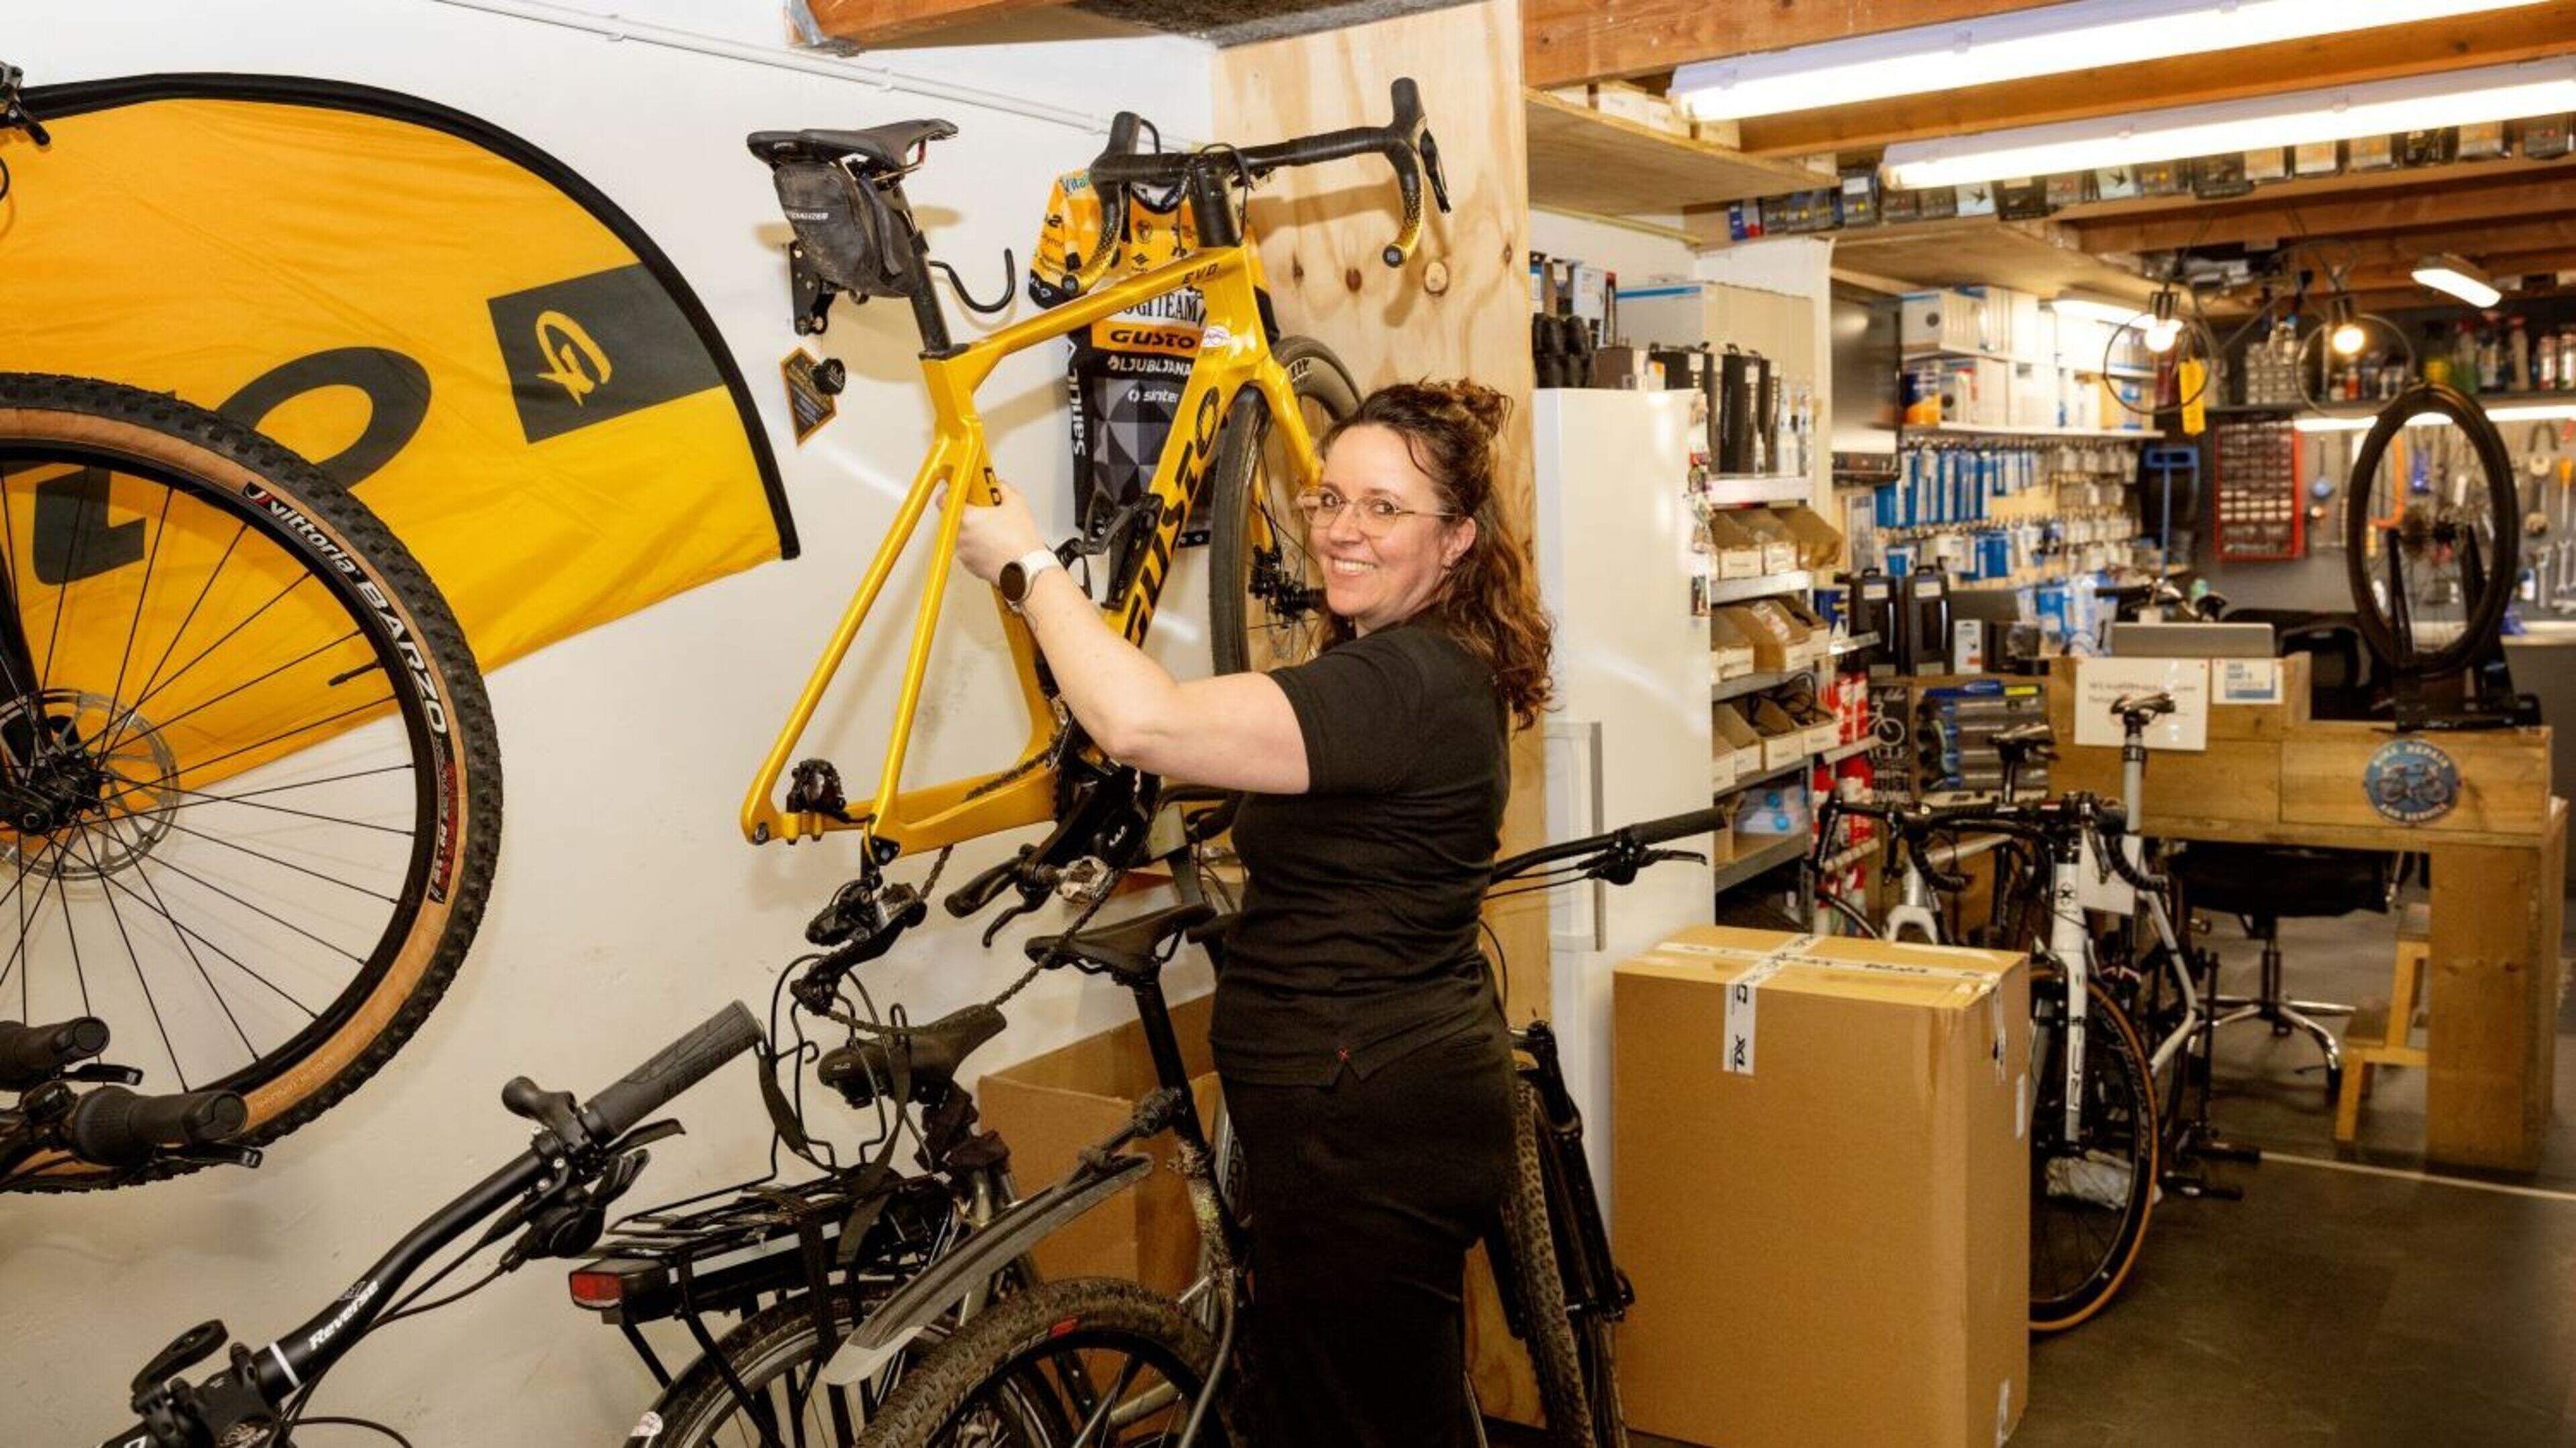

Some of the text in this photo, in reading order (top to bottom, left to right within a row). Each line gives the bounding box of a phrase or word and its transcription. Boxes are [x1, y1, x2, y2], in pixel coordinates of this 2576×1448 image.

[1110, 329, 1195, 349] GUSTO
[1120, 357, 1193, 376] LJUBLJANA
[356, 581, 447, 735] BARZO
[309, 1280, 379, 1351] Reverse
